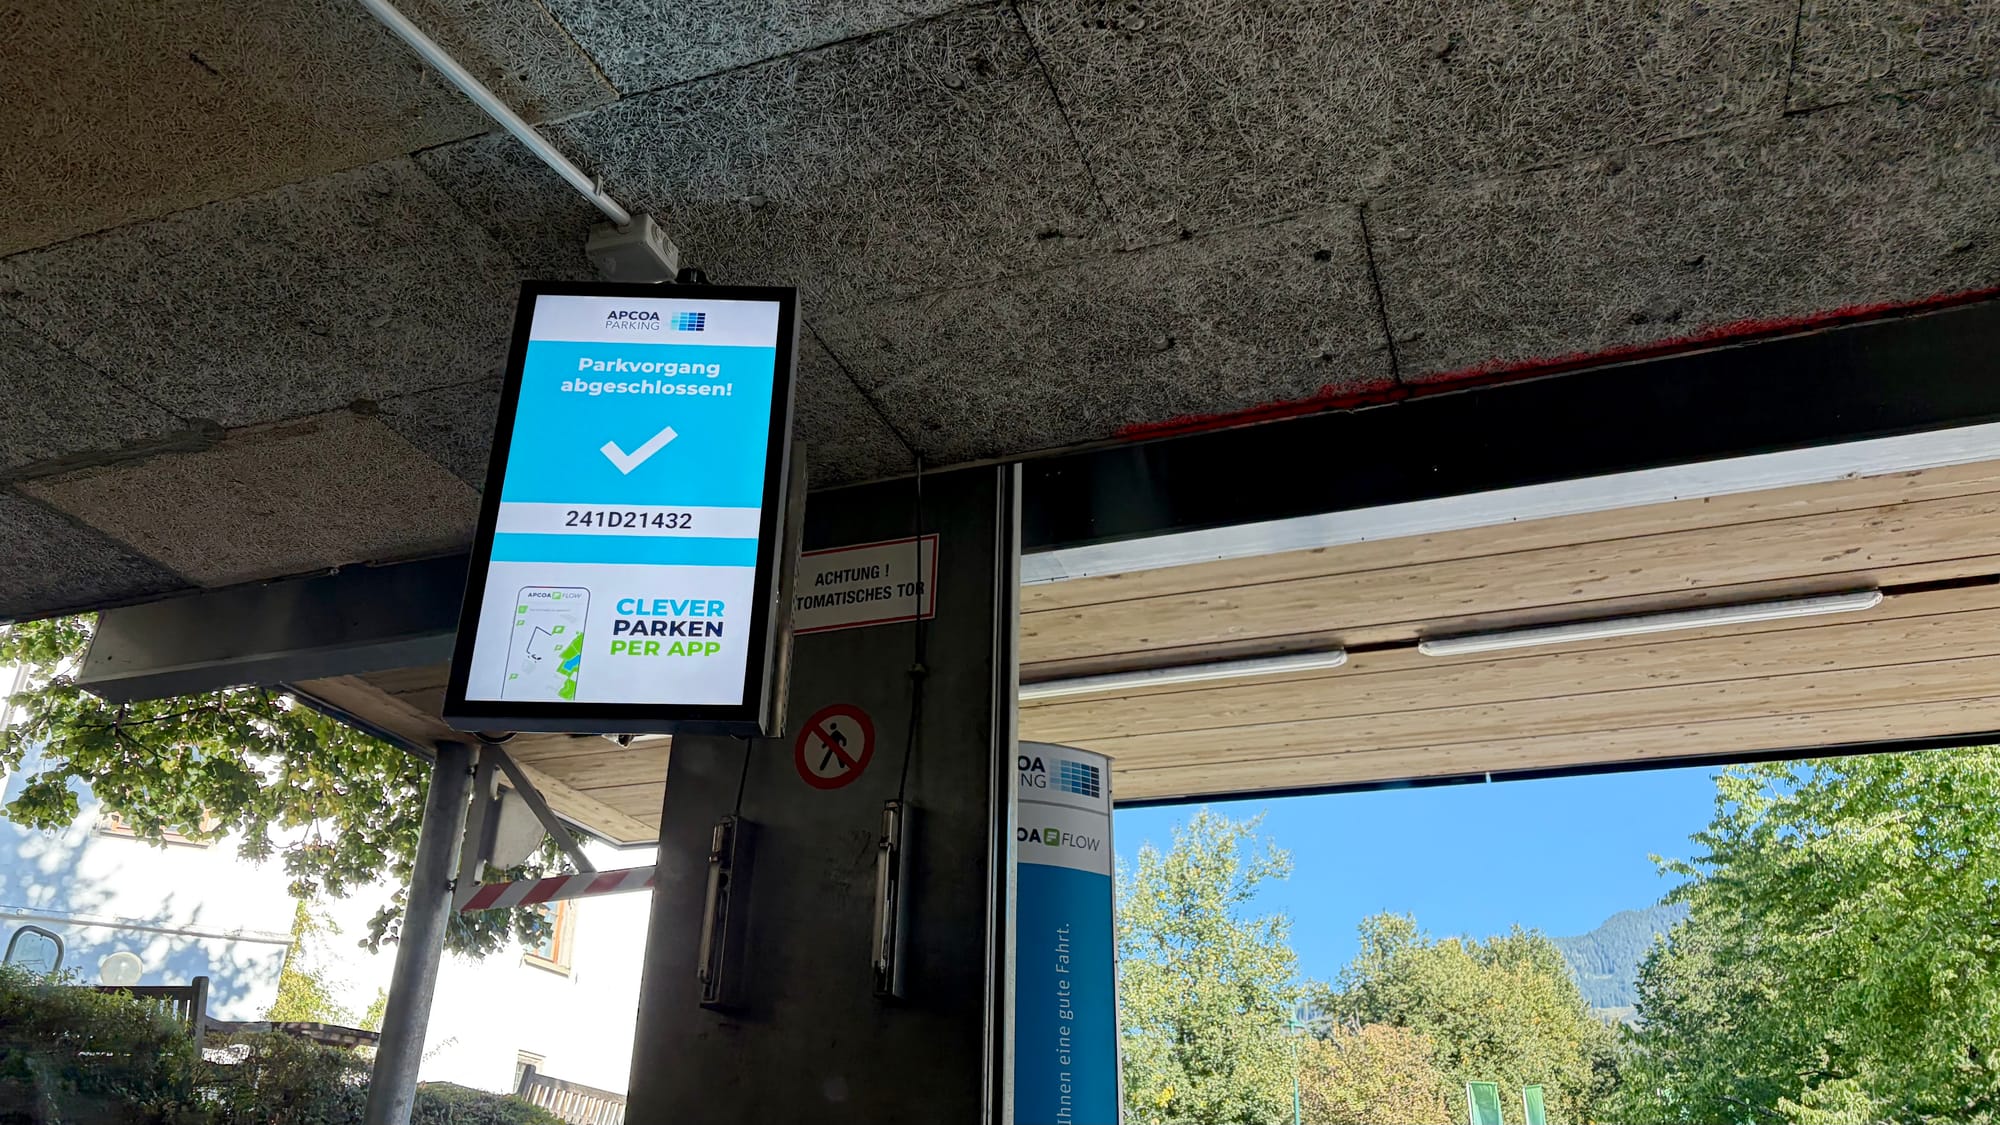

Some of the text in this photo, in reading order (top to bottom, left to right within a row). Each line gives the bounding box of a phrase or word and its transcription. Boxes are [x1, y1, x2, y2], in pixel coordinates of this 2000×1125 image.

[605, 320, 660, 331] PARKING
[607, 310, 660, 321] APCOA
[577, 357, 721, 378] Parkvorgang
[560, 378, 733, 397] abgeschlossen!
[565, 510, 693, 530] 241D21432
[815, 565, 880, 587] ACHTUNG
[616, 598, 726, 618] CLEVER
[797, 585, 892, 611] TOMATISCHES
[612, 620, 724, 638] PARKEN
[610, 640, 722, 657] PER APP
[1062, 832, 1101, 852] FLOW
[1055, 923, 1074, 1125] Ihnen eine gute Fahrt.
